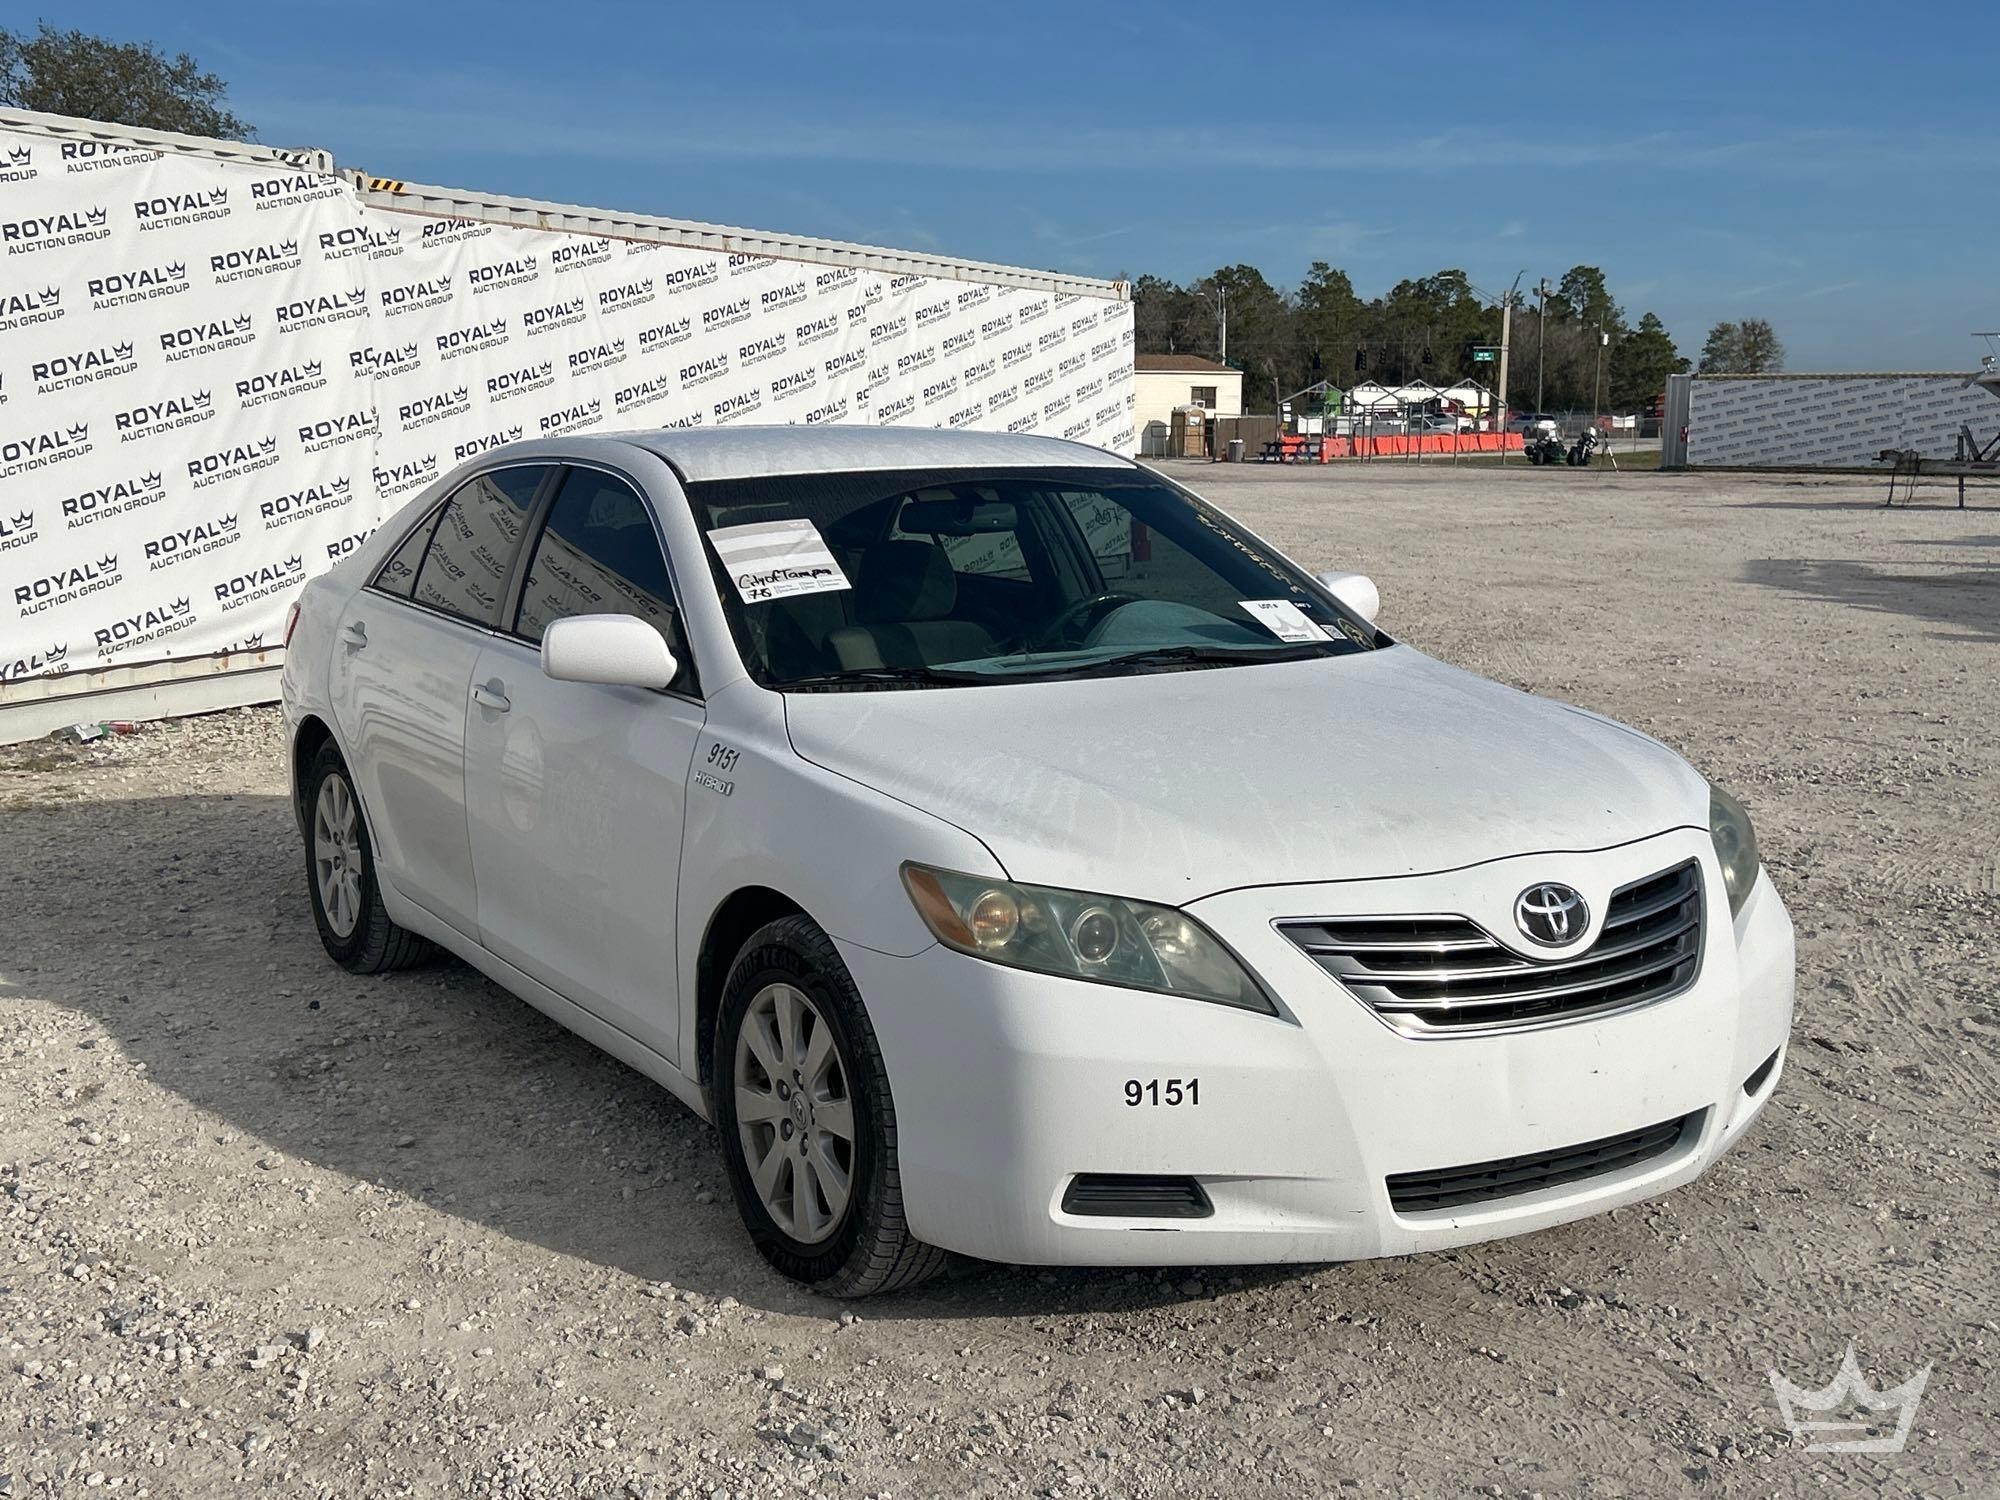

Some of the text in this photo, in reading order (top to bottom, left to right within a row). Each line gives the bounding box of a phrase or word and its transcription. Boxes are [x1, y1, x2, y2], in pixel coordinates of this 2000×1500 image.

[68, 151, 165, 173] AUCTION GROUP
[251, 174, 319, 198] ROYAL
[134, 193, 209, 218] ROYAL
[256, 188, 343, 211] AUCTION GROUP
[2, 212, 86, 241] ROYAL
[140, 208, 230, 232] AUCTION GROUP
[8, 229, 110, 255] AUCTION GROUP
[422, 228, 491, 249] AUCTION GROUP
[211, 244, 281, 272] ROYAL
[552, 242, 599, 264] ROYAL
[555, 254, 611, 274] AUCTION GROUP
[88, 266, 168, 297] ROYAL
[216, 259, 301, 284] AUCTION GROUP
[469, 260, 525, 284] ROYAL
[473, 272, 538, 295] AUCTION GROUP
[666, 264, 708, 285] ROYAL
[816, 269, 848, 287] ROYAL
[94, 282, 190, 310] AUCTION GROUP
[382, 280, 440, 306] ROYAL
[600, 282, 644, 305] ROYAL
[669, 275, 718, 295] AUCTION GROUP
[762, 285, 797, 304] ROYAL
[958, 288, 984, 304] ROYAL
[276, 294, 347, 322] ROYAL
[385, 293, 453, 317] AUCTION GROUP
[524, 302, 574, 326] ROYAL
[602, 294, 655, 315] AUCTION GROUP
[703, 303, 740, 324] ROYAL
[916, 304, 943, 320] ROYAL
[1020, 302, 1042, 318] ROYAL
[1104, 303, 1123, 316] ROYAL
[280, 306, 369, 334] AUCTION GROUP
[527, 314, 586, 336] AUCTION GROUP
[797, 318, 830, 338] ROYAL
[870, 321, 900, 338] ROYAL
[982, 317, 1006, 333] ROYAL
[1072, 316, 1092, 330] ROYAL
[160, 319, 234, 350] ROYAL
[436, 324, 493, 350] ROYAL
[639, 322, 681, 345] ROYAL
[642, 333, 692, 354] AUCTION GROUP
[943, 334, 968, 350] ROYAL
[1039, 330, 1061, 346] ROYAL
[166, 334, 255, 362] AUCTION GROUP
[441, 336, 509, 361] AUCTION GROUP
[569, 342, 614, 367] ROYAL
[740, 337, 776, 359] ROYAL
[898, 350, 927, 368] ROYAL
[1002, 345, 1026, 362] ROYAL
[1092, 340, 1112, 356] ROYAL
[32, 346, 115, 381] ROYAL
[572, 354, 627, 377] AUCTION GROUP
[680, 358, 719, 381] ROYAL
[826, 352, 857, 372] ROYAL
[964, 361, 989, 379] ROYAL
[1059, 357, 1080, 371] ROYAL
[1108, 366, 1128, 381] ROYAL
[38, 362, 137, 395] AUCTION GROUP
[236, 366, 304, 397] ROYAL
[487, 366, 542, 392] ROYAL
[490, 378, 554, 403] AUCTION GROUP
[772, 370, 807, 393] ROYAL
[924, 379, 951, 398] ROYAL
[1024, 372, 1048, 388] ROYAL
[1076, 381, 1098, 397] ROYAL
[241, 379, 327, 409] AUCTION GROUP
[615, 380, 658, 405] ROYAL
[617, 390, 668, 414] AUCTION GROUP
[989, 388, 1012, 406] ROYAL
[116, 396, 194, 430] ROYAL
[399, 391, 455, 420] ROYAL
[540, 403, 591, 430] ROYAL
[714, 394, 750, 416] ROYAL
[806, 402, 839, 424] ROYAL
[878, 398, 908, 418] ROYAL
[950, 406, 975, 426] ROYAL
[1044, 397, 1066, 414] ROYAL
[1096, 404, 1116, 420] ROYAL
[121, 410, 215, 443] AUCTION GROUP
[300, 416, 372, 442] ROYAL
[403, 404, 470, 432] AUCTION GROUP
[1008, 415, 1032, 432] ROYAL
[1064, 421, 1085, 438] ROYAL
[455, 430, 511, 460] ROYAL
[1113, 428, 1133, 444] ROYAL
[188, 444, 260, 477] ROYAL
[194, 455, 279, 489] AUCTION GROUP
[62, 482, 142, 516] ROYAL
[68, 492, 165, 530] AUCTION GROUP
[261, 484, 333, 518] ROYAL
[266, 495, 352, 530] AUCTION GROUP
[145, 521, 221, 558] ROYAL
[150, 532, 240, 571] AUCTION GROUP
[15, 563, 99, 604] ROYAL
[215, 562, 286, 600] ROYAL
[222, 573, 306, 612] AUCTION GROUP
[21, 574, 122, 618] AUCTION GROUP
[96, 605, 173, 646] ROYAL
[98, 616, 196, 658] AUCTION GROUP
[708, 743, 741, 772] 9151
[1124, 1078, 1199, 1107] 9151
